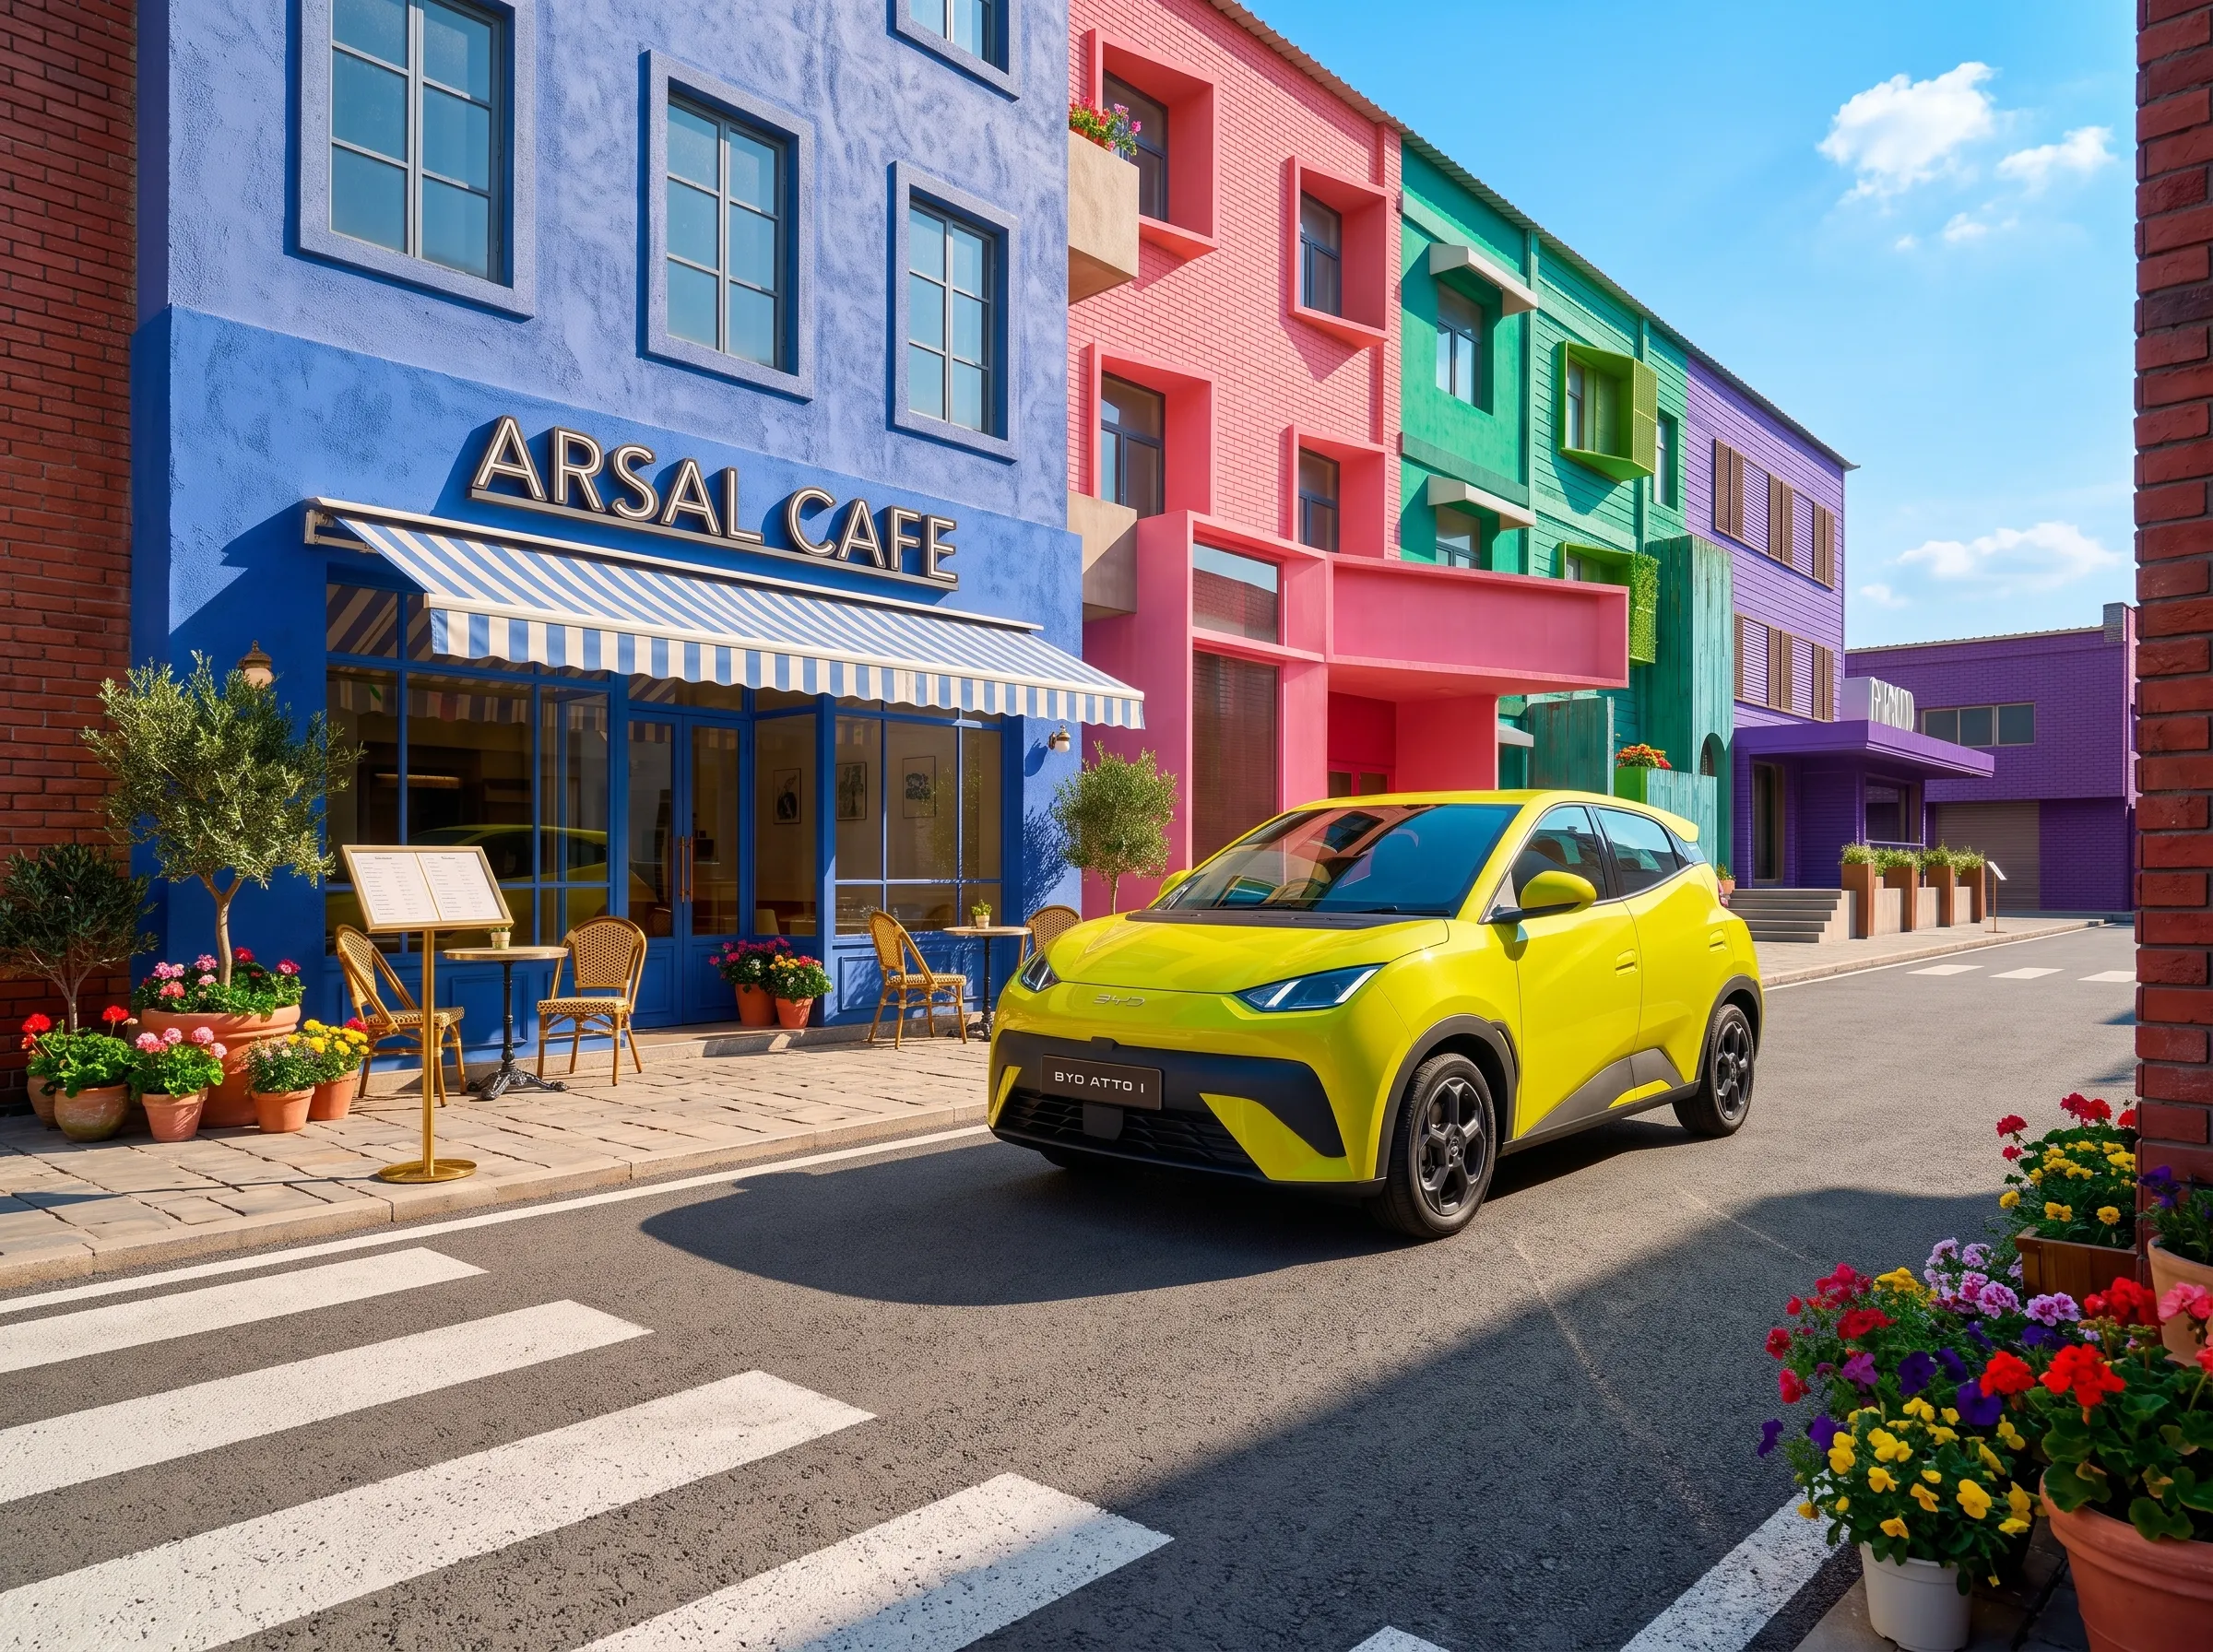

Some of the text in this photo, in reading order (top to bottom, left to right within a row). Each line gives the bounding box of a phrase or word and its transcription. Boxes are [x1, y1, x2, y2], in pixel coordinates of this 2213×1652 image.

[472, 415, 958, 583] ARSAL CAFE
[1090, 1077, 1132, 1092] ATTO
